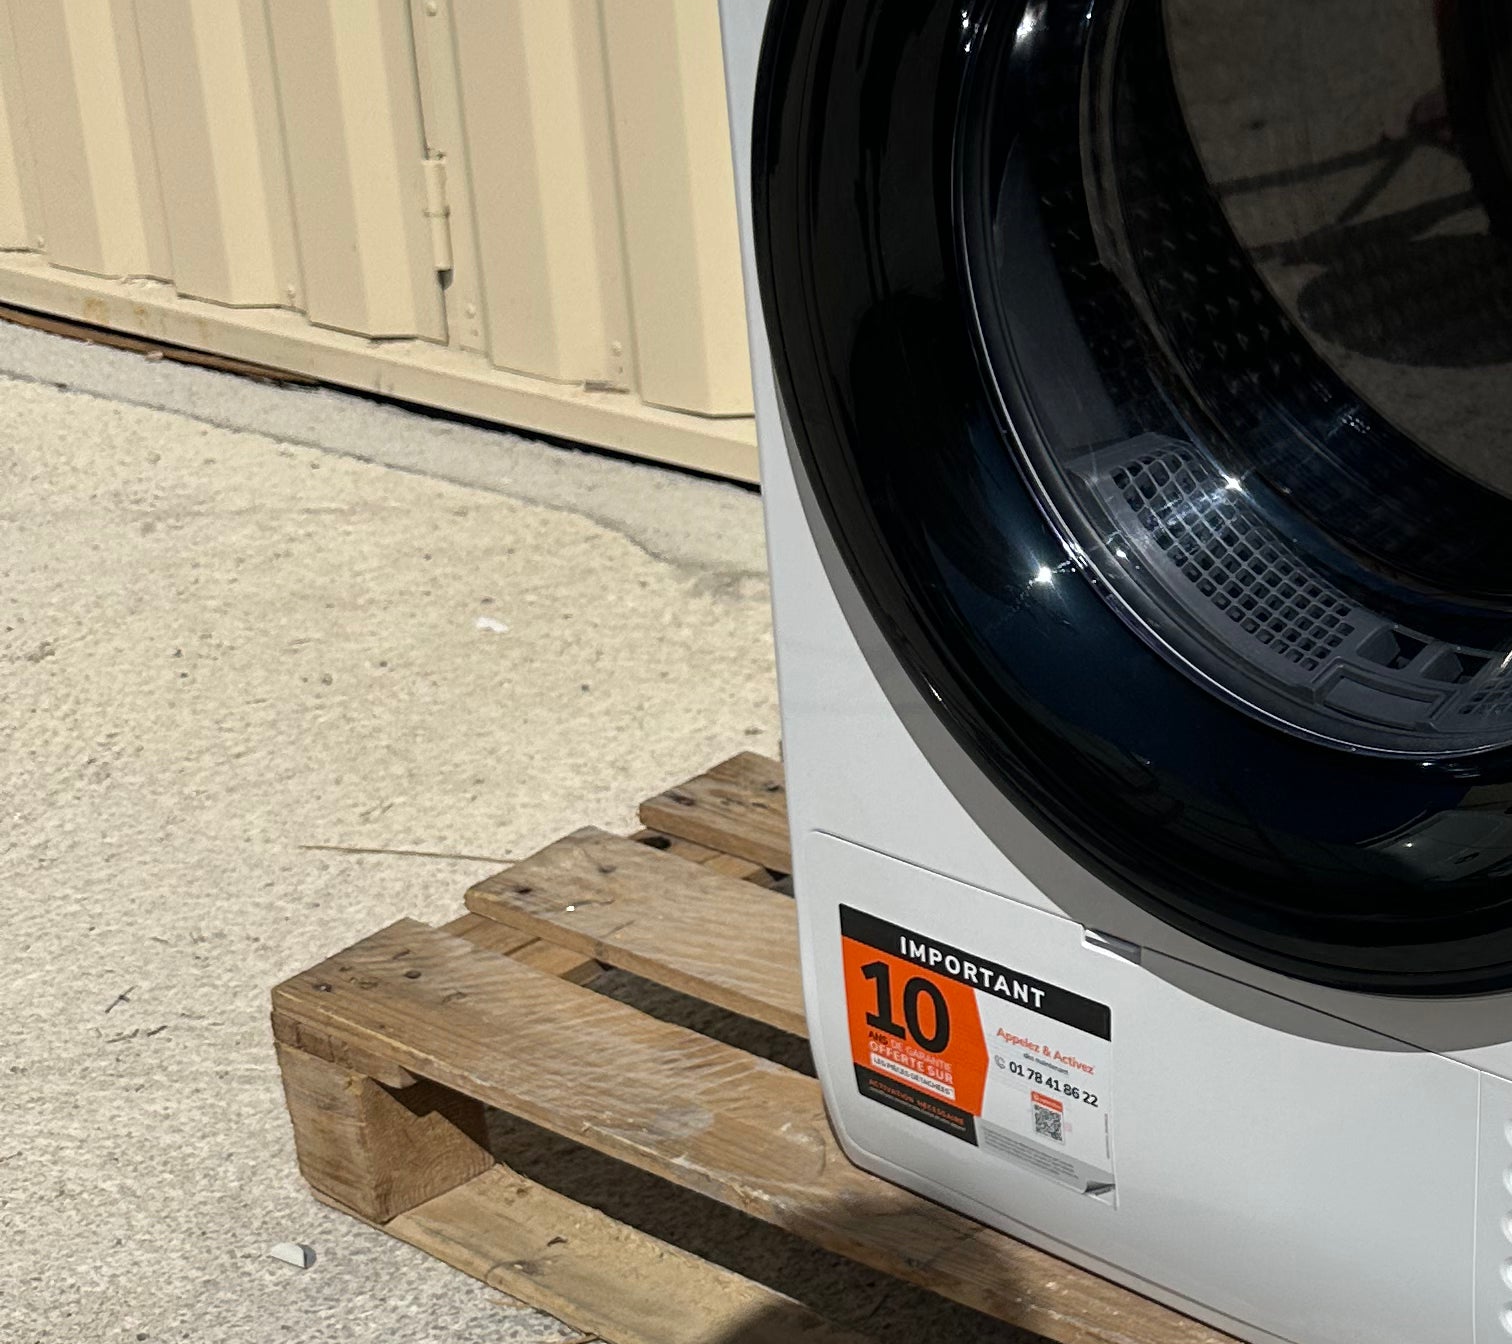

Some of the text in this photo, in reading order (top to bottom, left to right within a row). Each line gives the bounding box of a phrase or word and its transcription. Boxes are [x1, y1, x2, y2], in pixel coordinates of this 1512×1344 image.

[900, 936, 1045, 1008] IMPORTANT
[861, 960, 950, 1053] 10
[927, 1065, 953, 1085] SUR
[997, 1028, 1094, 1075] Appelez & Activez
[1009, 1061, 1098, 1107] 01 78 41 86 22
